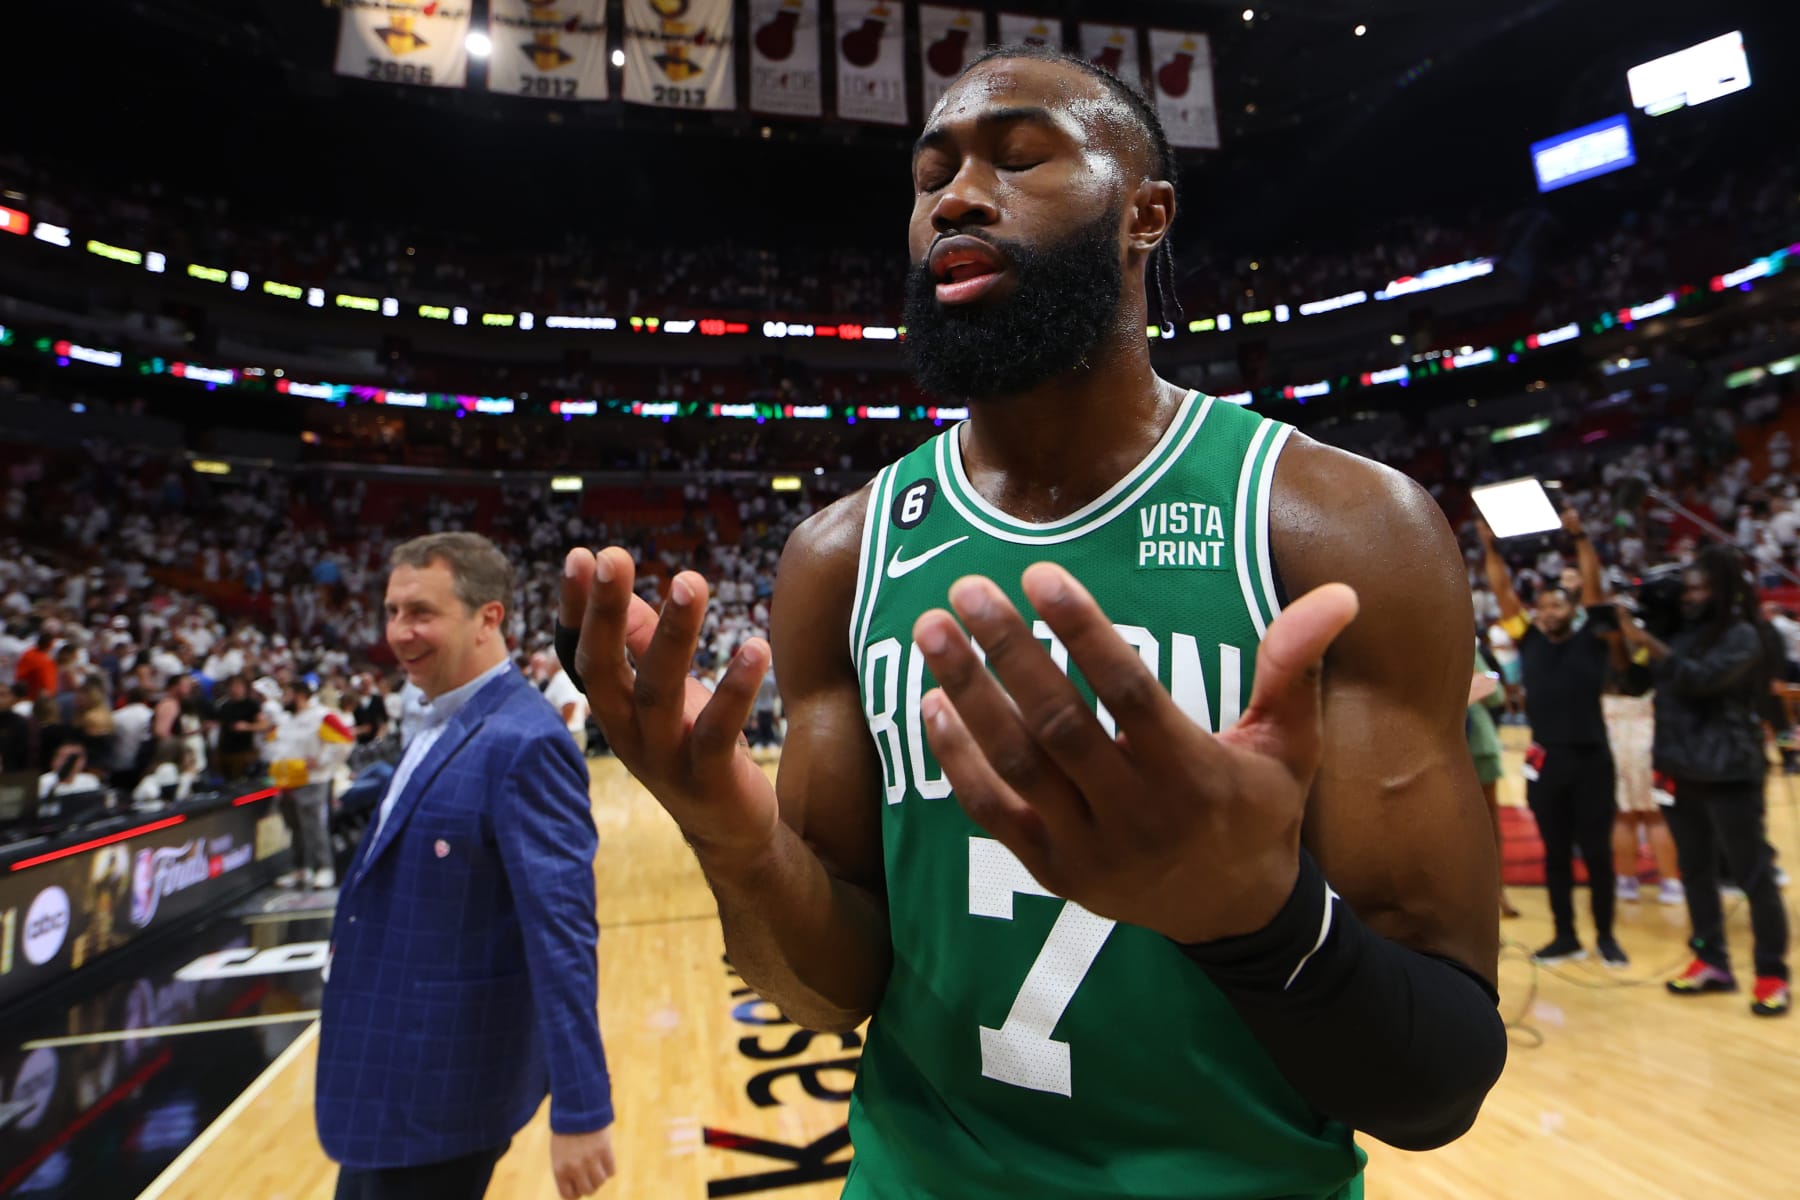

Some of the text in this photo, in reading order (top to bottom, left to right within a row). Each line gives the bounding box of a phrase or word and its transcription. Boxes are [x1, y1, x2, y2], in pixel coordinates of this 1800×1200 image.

[520, 74, 579, 98] 2012
[654, 84, 707, 107] 2013
[901, 484, 928, 523] 6
[1140, 502, 1224, 539] VISTA
[1139, 541, 1225, 566] PRINT
[864, 620, 1241, 805] BON
[969, 836, 1117, 1097] 7
